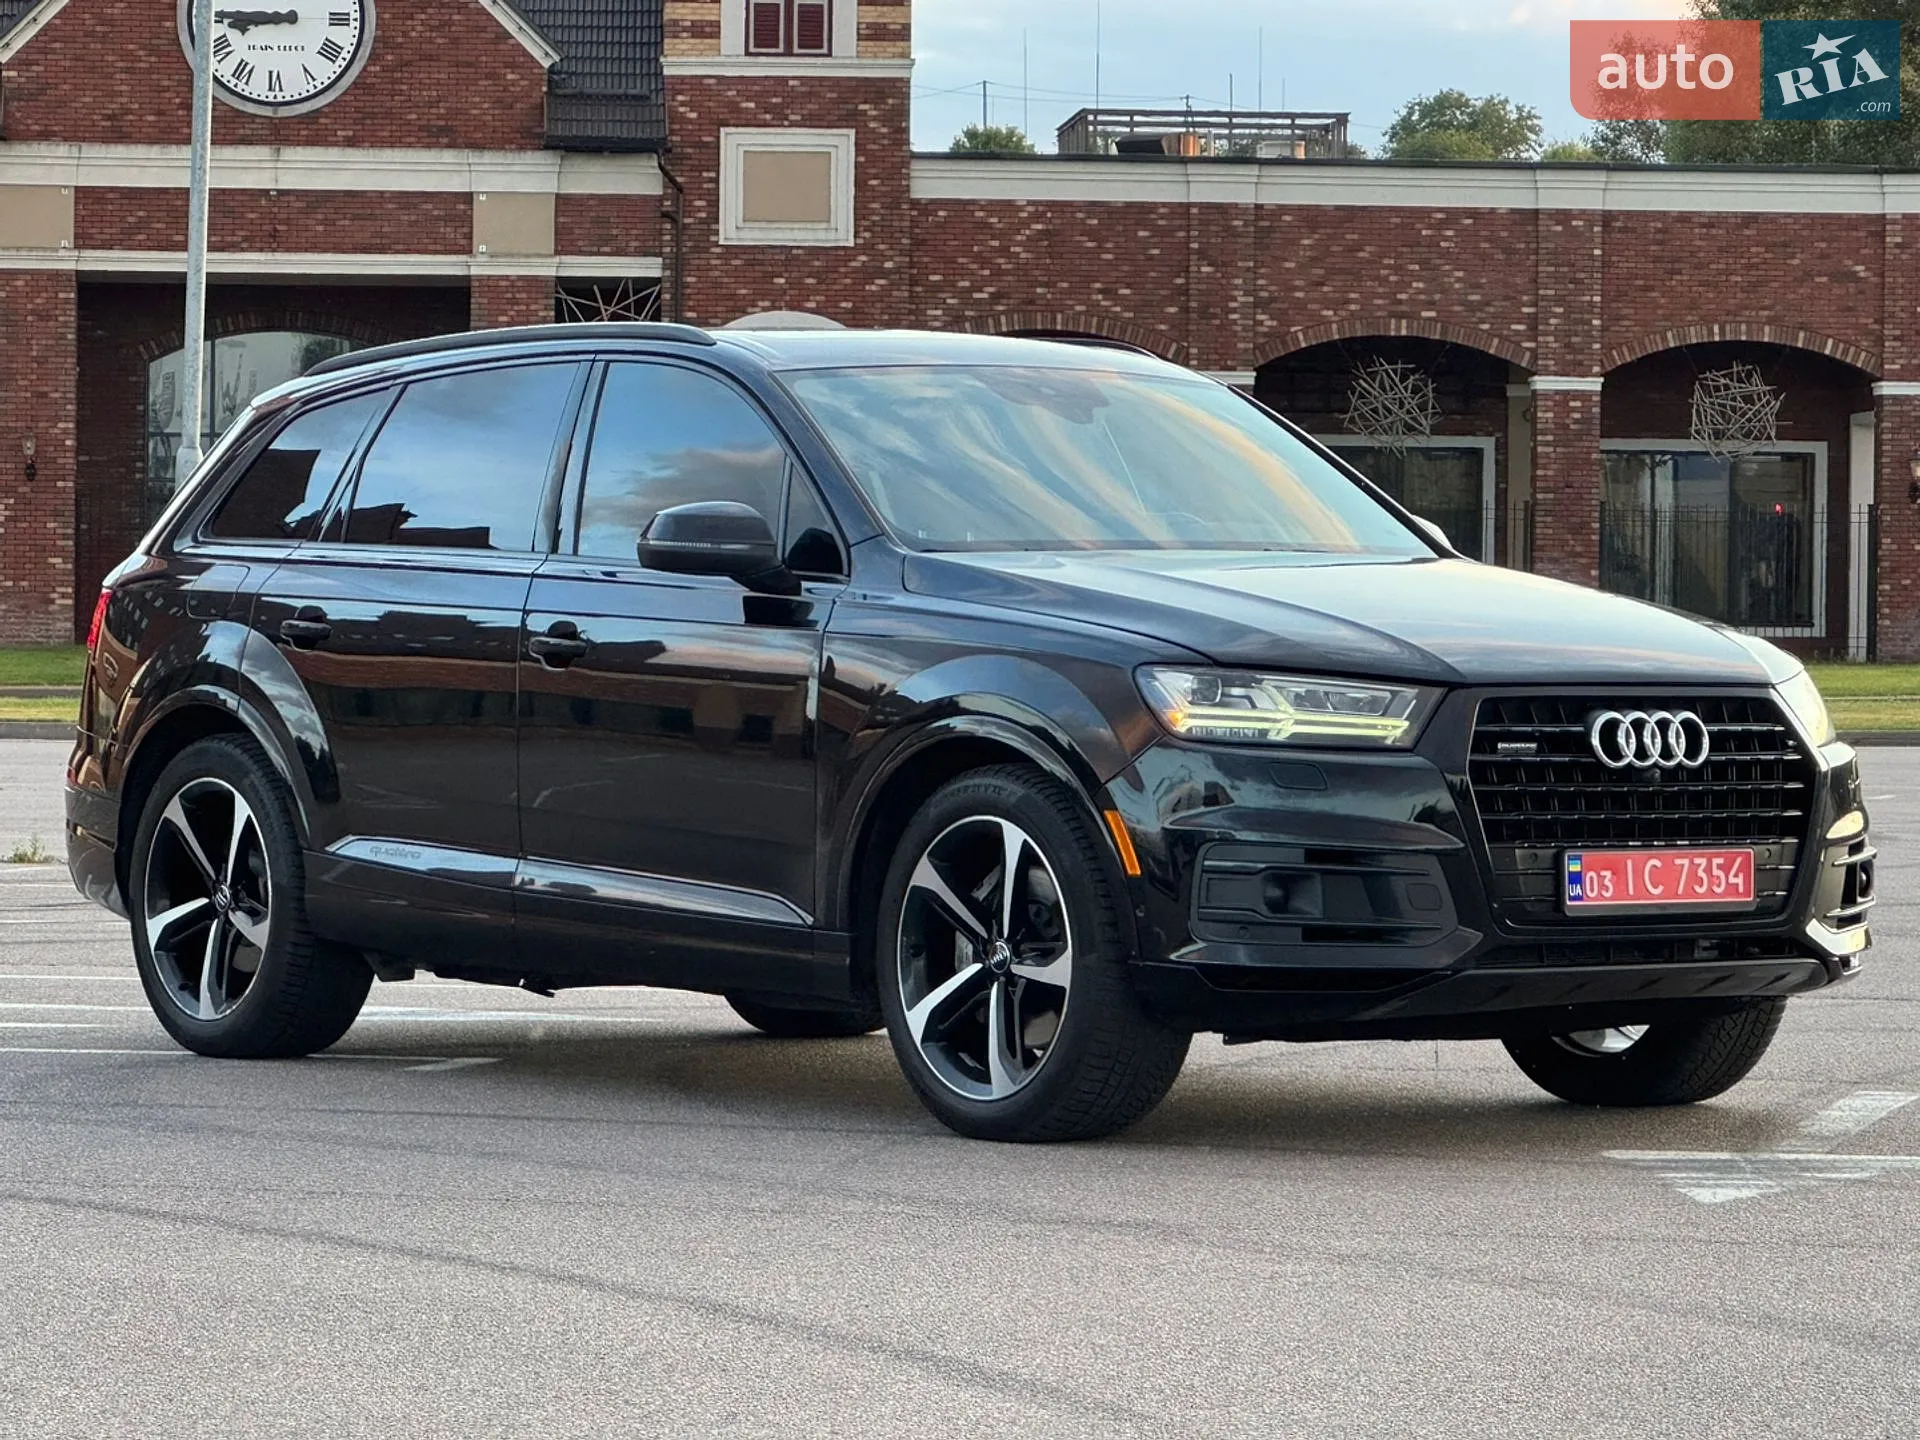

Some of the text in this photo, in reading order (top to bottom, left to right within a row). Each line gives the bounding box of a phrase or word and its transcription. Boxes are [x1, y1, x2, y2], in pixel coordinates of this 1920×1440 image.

[1569, 884, 1582, 896] UA
[1585, 870, 1614, 898] 03
[1674, 856, 1744, 895] 7354
